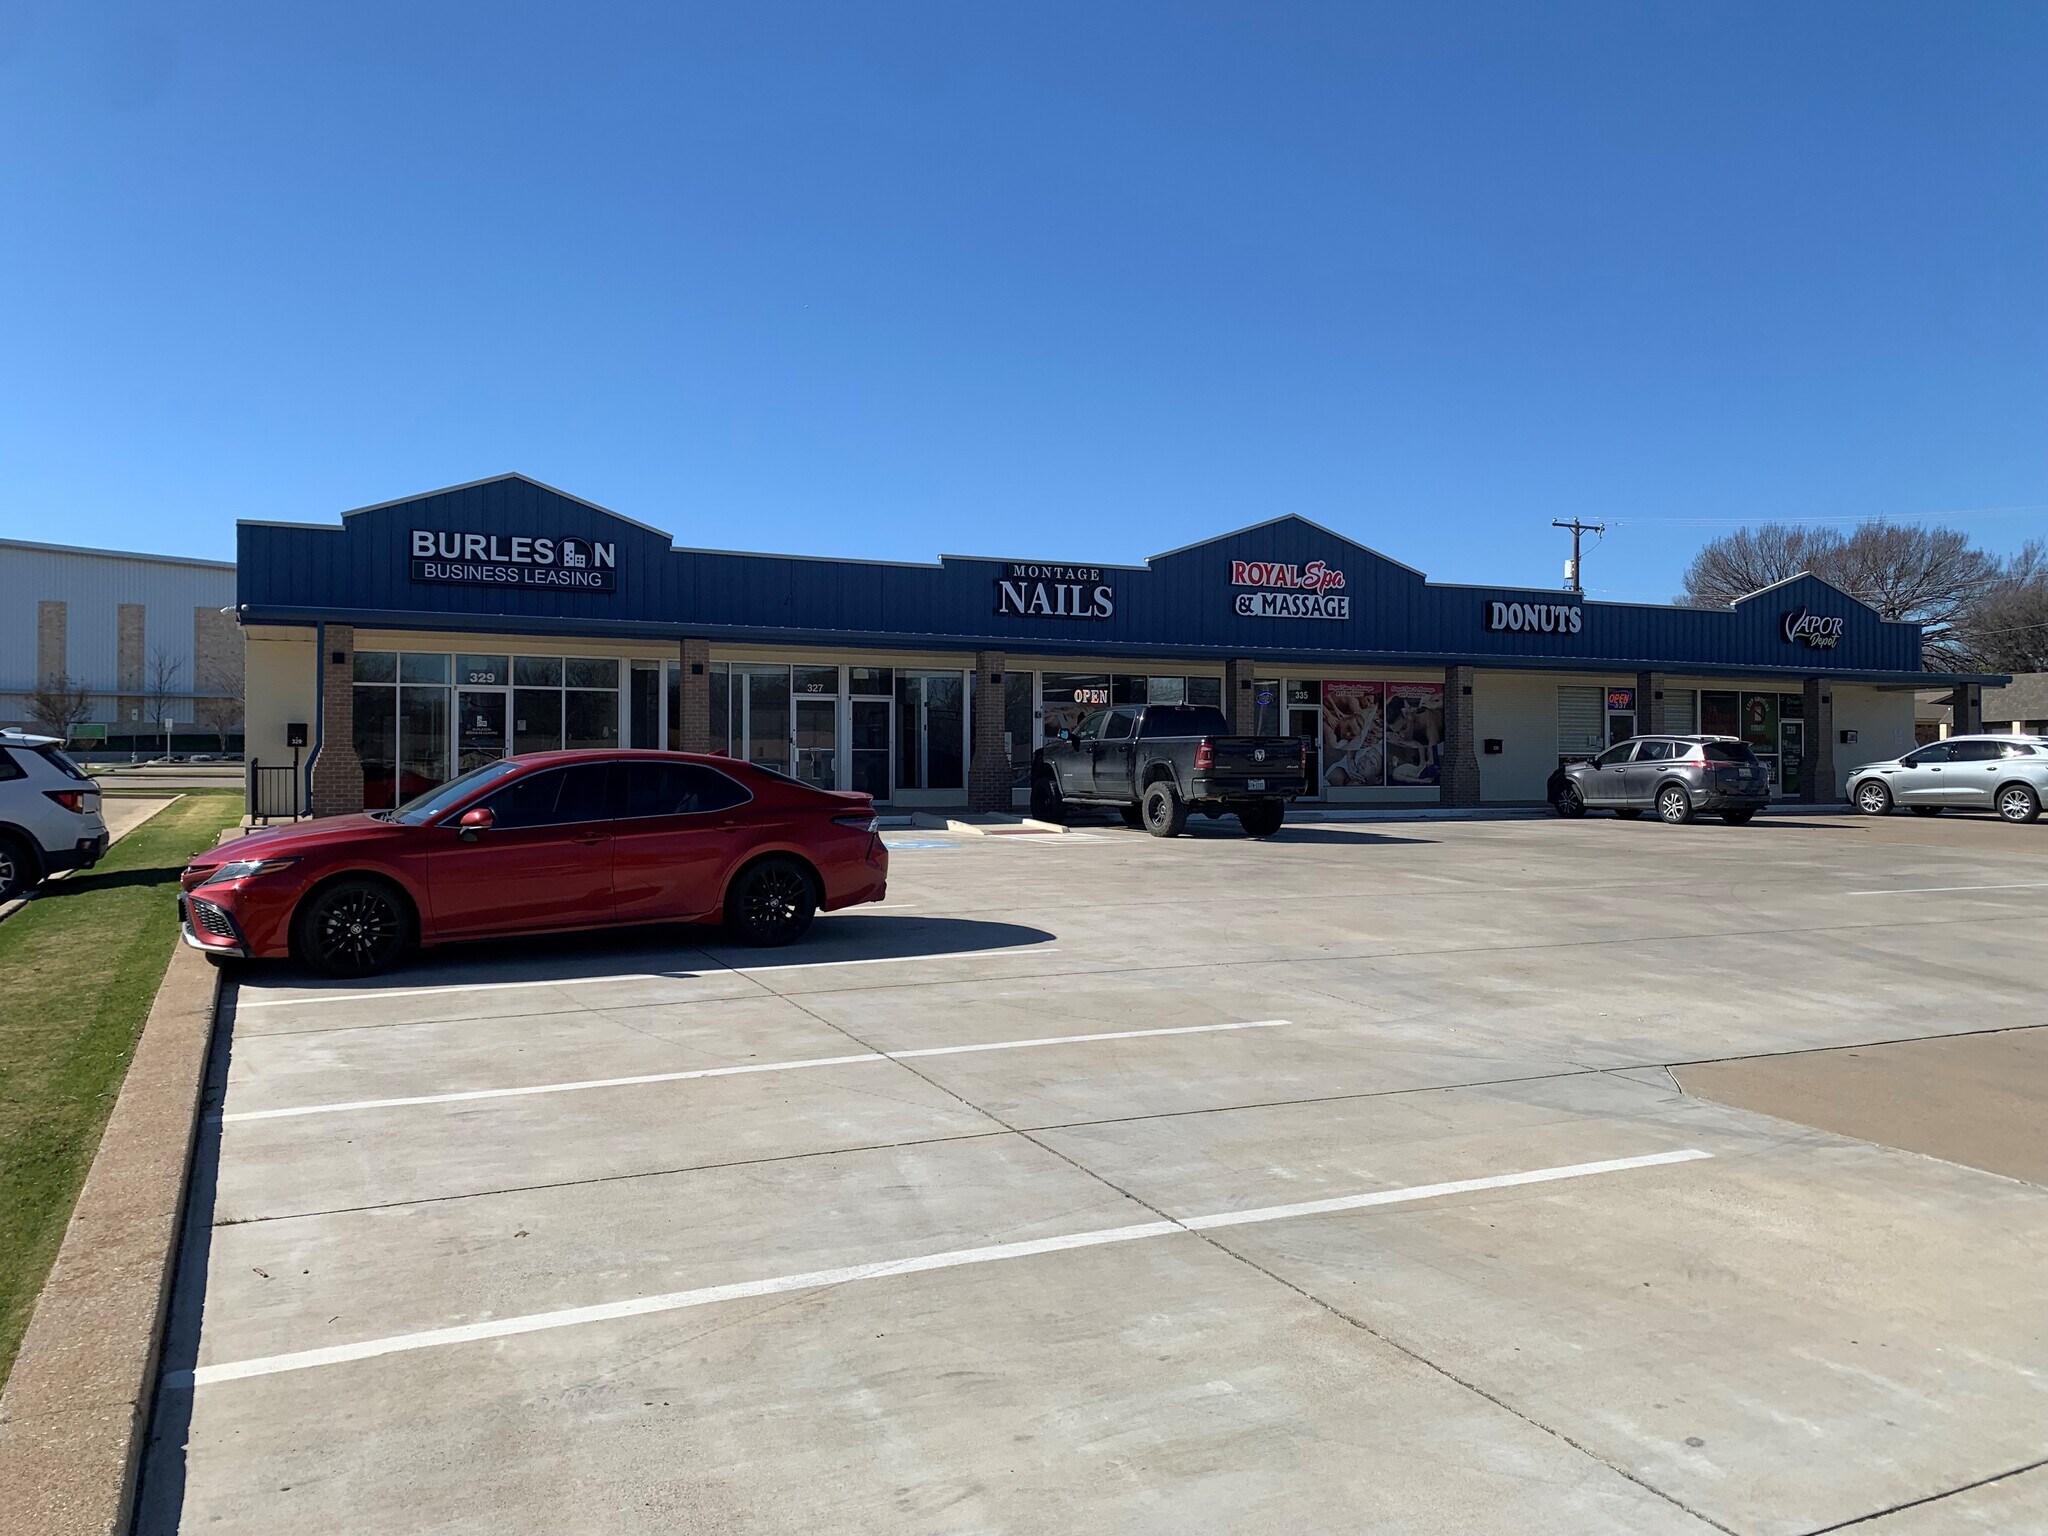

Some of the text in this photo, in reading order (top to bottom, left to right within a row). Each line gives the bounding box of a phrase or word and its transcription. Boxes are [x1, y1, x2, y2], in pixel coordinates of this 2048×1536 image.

[424, 563, 602, 587] BUSINESS LEASING
[1013, 564, 1100, 581] MONTAGE
[1232, 560, 1345, 595] ROYAL Spa
[999, 581, 1113, 618] NAILS
[1237, 594, 1348, 618] & MASSAGE
[1491, 602, 1582, 633] DONUTS
[1785, 608, 1844, 642] VAPOR
[1809, 632, 1841, 648] Depot
[469, 672, 495, 683] 329
[806, 683, 824, 692] 327
[1294, 691, 1309, 699] 335
[1074, 689, 1108, 703] OPEN
[1608, 693, 1630, 704] OPEN
[1614, 701, 1627, 709] 337
